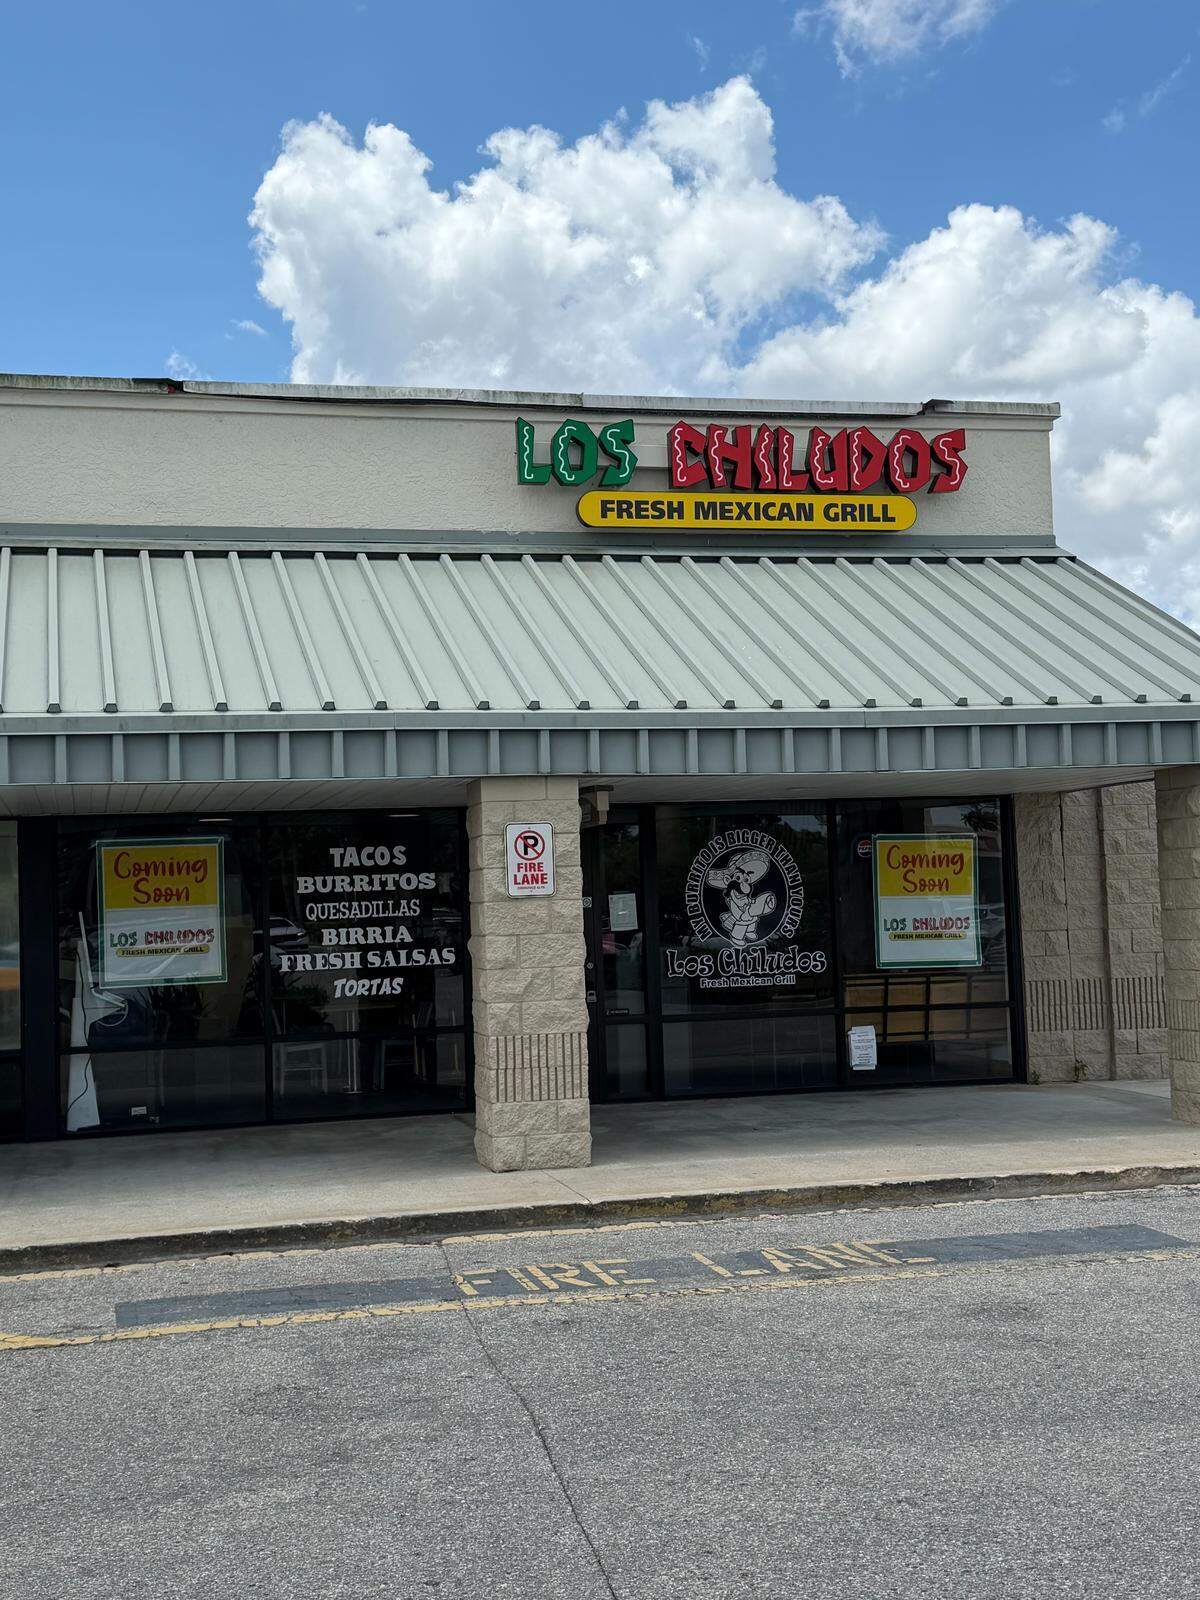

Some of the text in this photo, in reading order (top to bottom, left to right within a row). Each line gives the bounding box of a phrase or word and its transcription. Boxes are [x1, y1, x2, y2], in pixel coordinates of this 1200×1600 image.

[516, 416, 969, 494] LOS CHILUDOS
[600, 499, 896, 524] FRESH MEXICAN GRILL
[113, 851, 208, 884] Coming
[329, 845, 407, 868] TACOS
[516, 861, 544, 873] FIRE
[886, 844, 965, 876] Coming
[132, 876, 190, 905] Soon
[296, 872, 437, 894] BURRITOS
[513, 872, 549, 886] LANE
[685, 828, 804, 942] MY BURRITO IS BIGGER THAN YOURS
[902, 868, 950, 894] Soon
[305, 899, 421, 922] QUESADILLAS
[321, 925, 414, 946] BIRRIA
[883, 916, 971, 932] LOS CHILUDOS
[109, 927, 215, 948] LOS CHILUDOS
[121, 947, 146, 956] FRESH
[147, 946, 181, 955] MEXICAN
[279, 947, 456, 973] FRESH SALSAS
[666, 945, 827, 978] Los Chiludos
[333, 977, 404, 999] TORTAS
[700, 974, 796, 989] Fresh Mexican Grill
[452, 1239, 936, 1297] FIRE LANE
